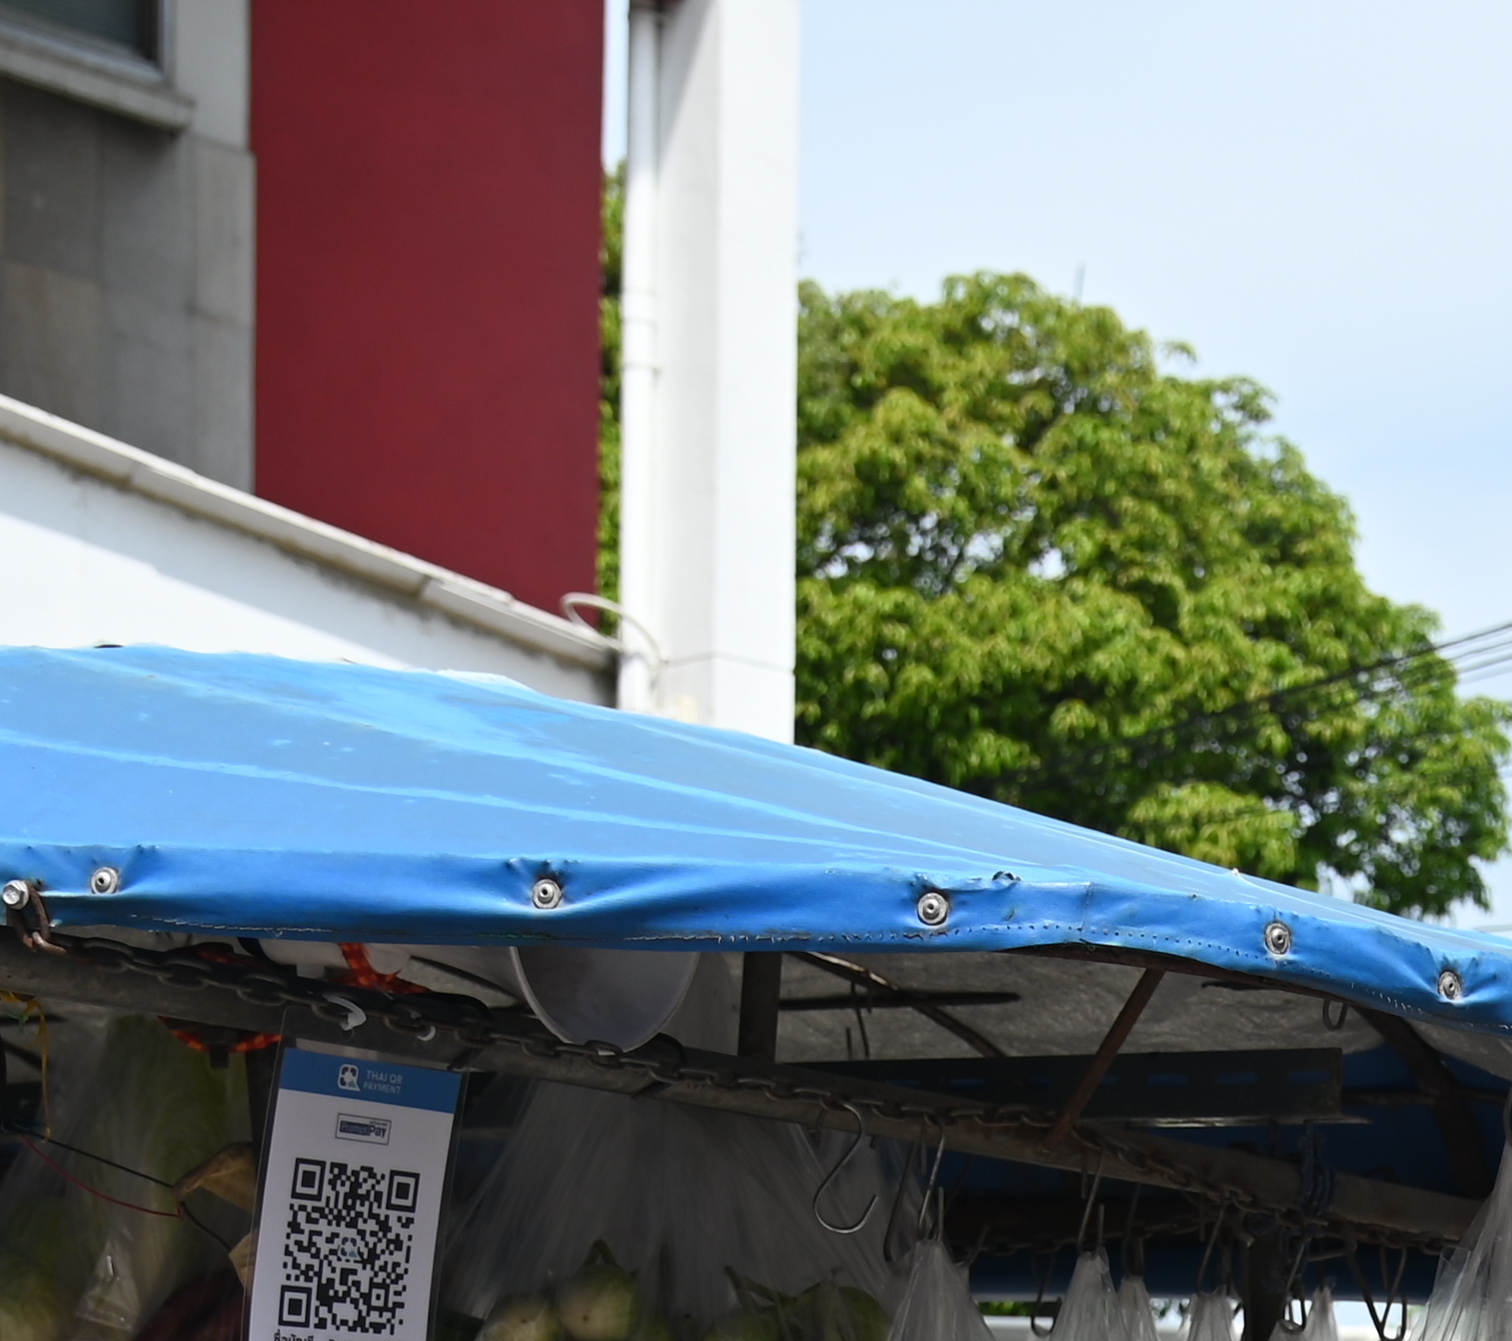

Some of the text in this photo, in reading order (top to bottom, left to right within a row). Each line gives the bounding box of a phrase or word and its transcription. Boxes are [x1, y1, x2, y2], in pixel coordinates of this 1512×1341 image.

[365, 1069, 404, 1085] THAI QR
[363, 1080, 403, 1095] PAYMENT
